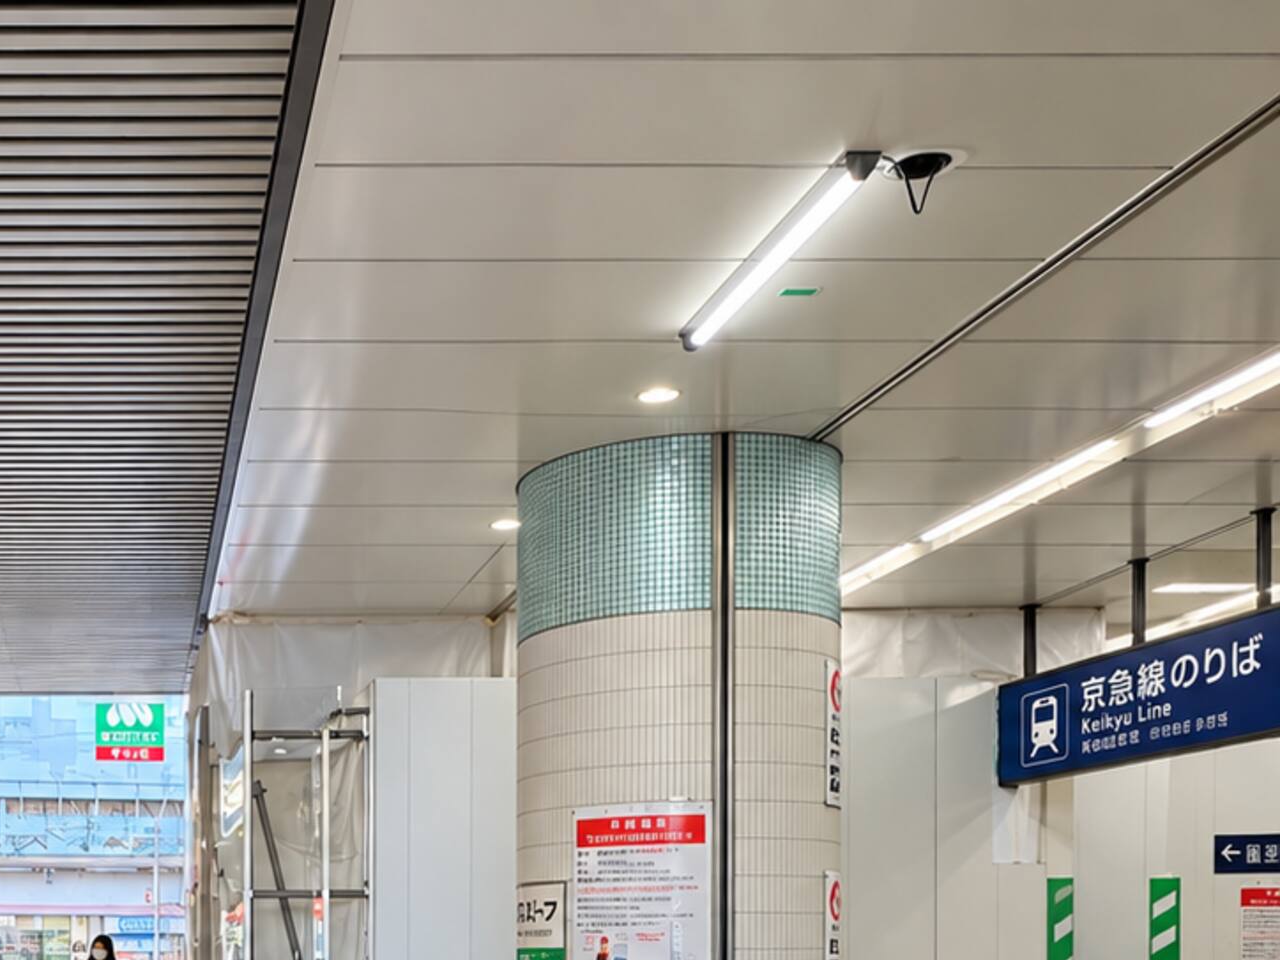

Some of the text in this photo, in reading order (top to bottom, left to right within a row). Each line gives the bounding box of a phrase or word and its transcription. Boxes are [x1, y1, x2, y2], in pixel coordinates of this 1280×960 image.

[1080, 632, 1264, 713] 京急線のりば
[1081, 712, 1133, 735] Keikyu
[1137, 701, 1172, 723] Line
